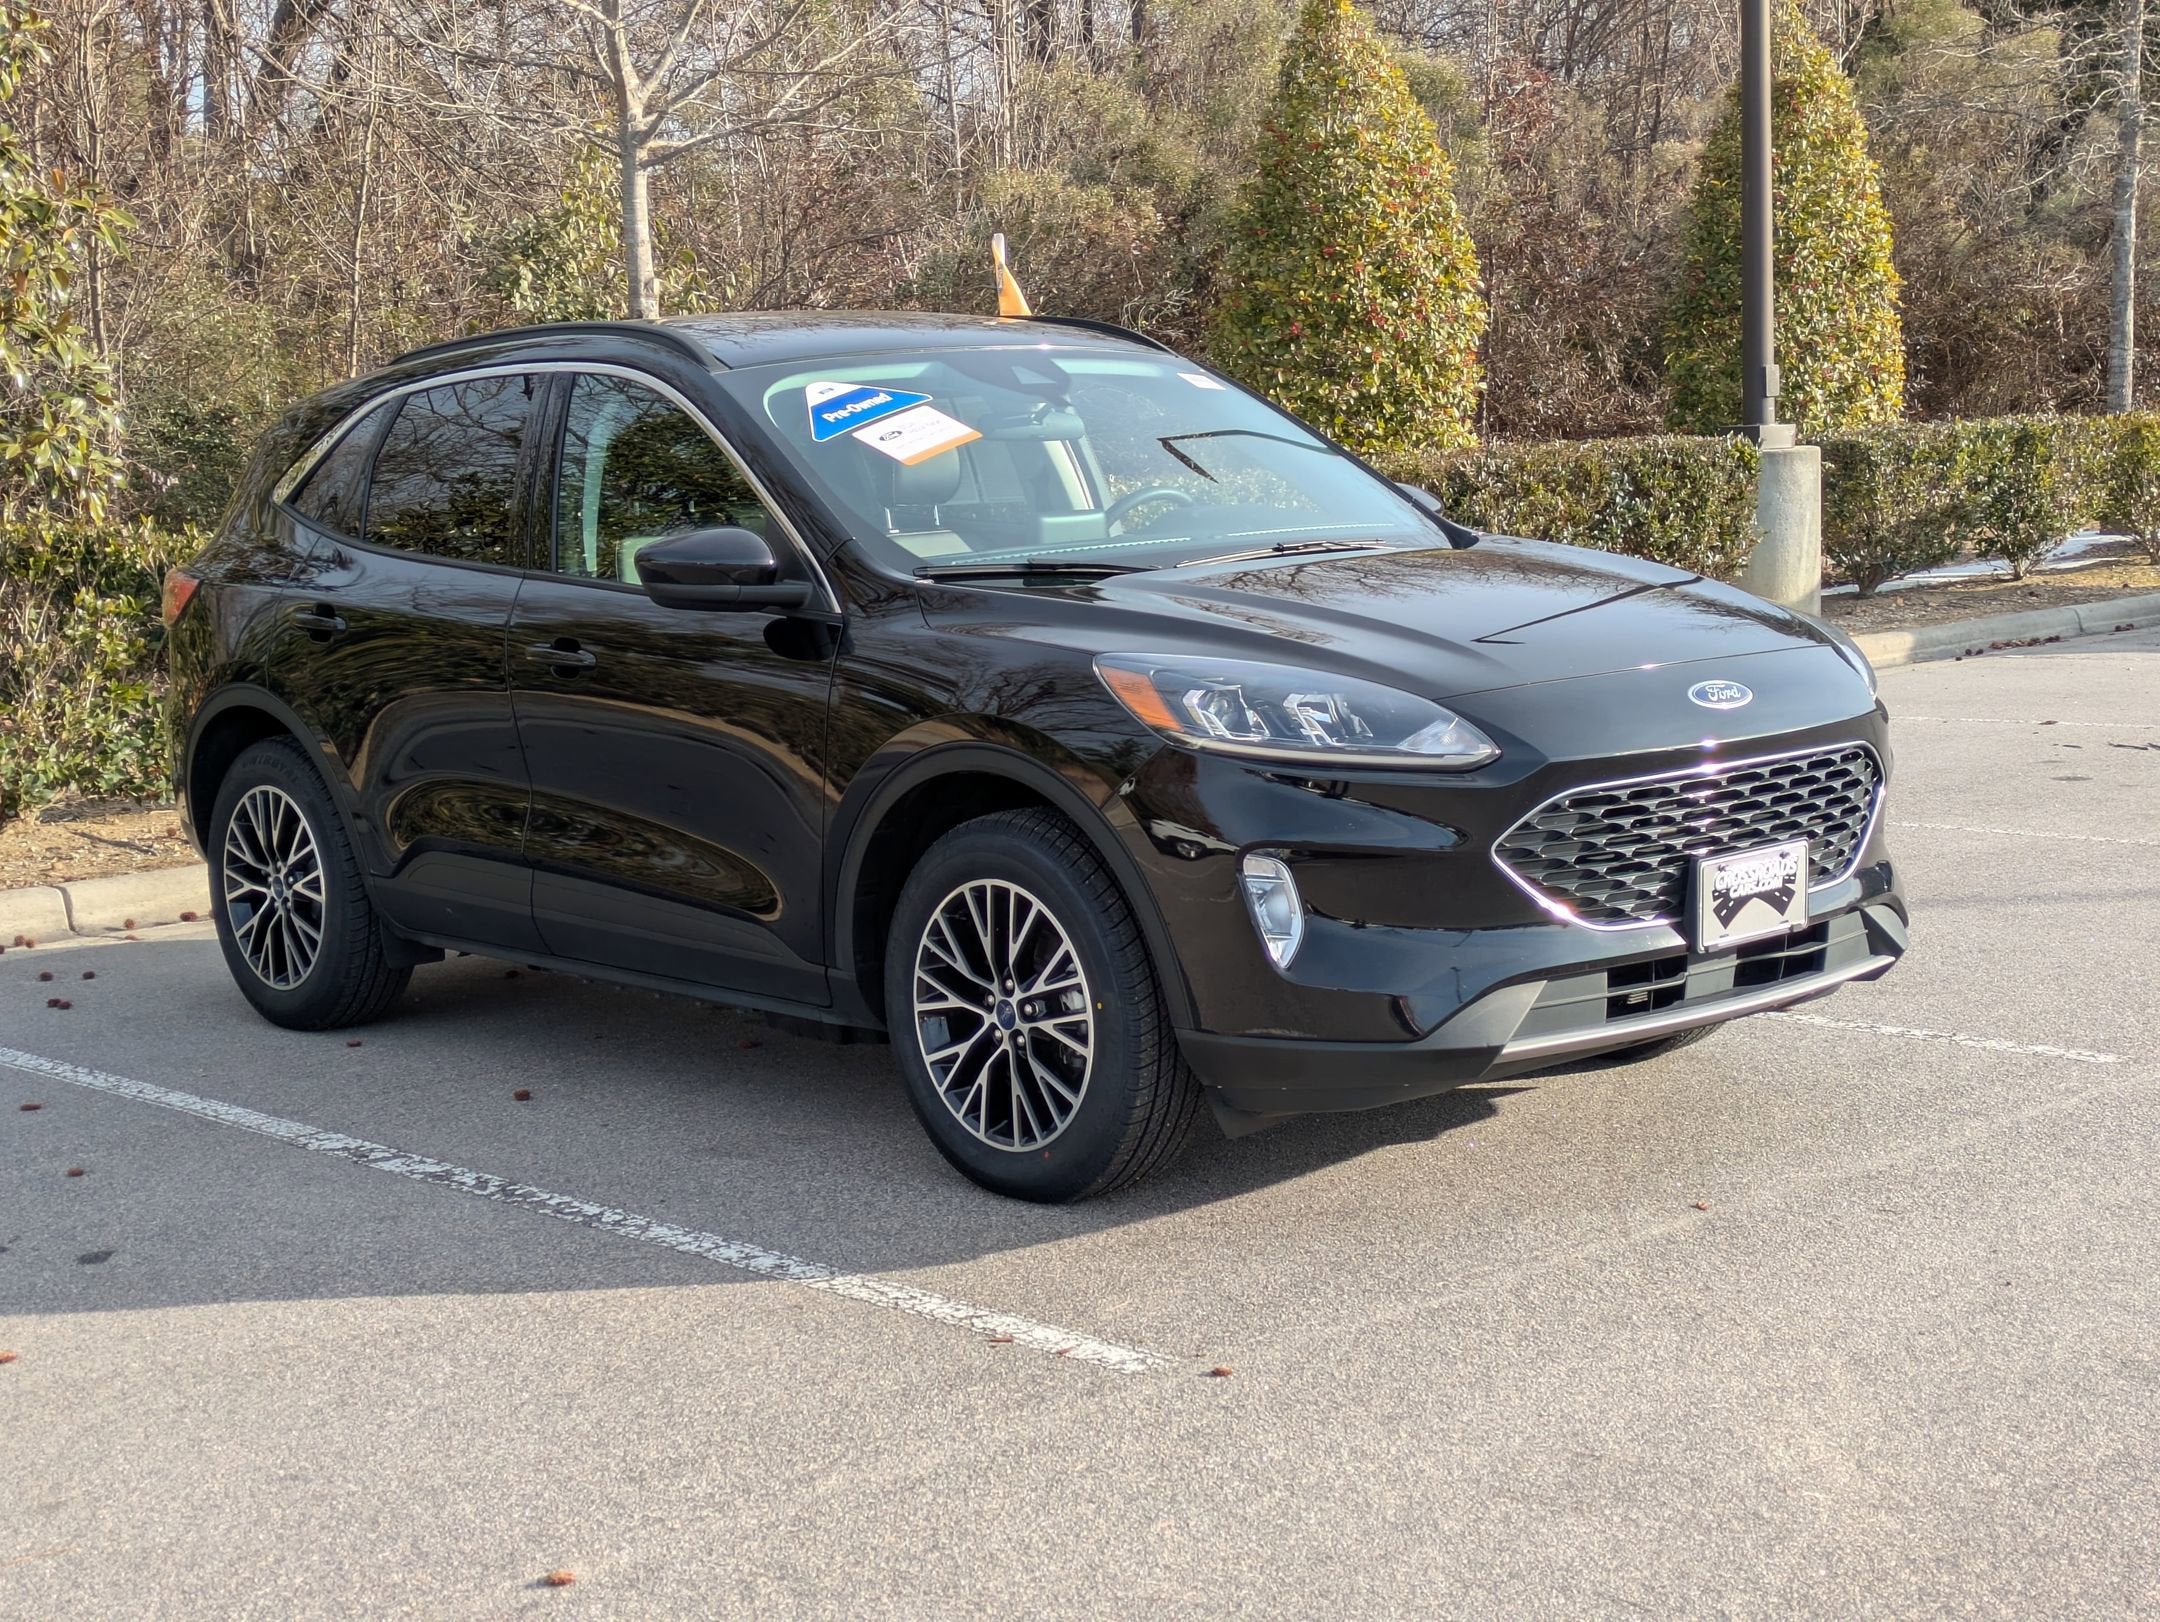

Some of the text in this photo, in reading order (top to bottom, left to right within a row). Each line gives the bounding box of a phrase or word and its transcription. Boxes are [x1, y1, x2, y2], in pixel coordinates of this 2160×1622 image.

[822, 392, 893, 422] Pre-Owned
[1705, 684, 1741, 701] Ford
[1714, 856, 1798, 890] CROSSROADS
